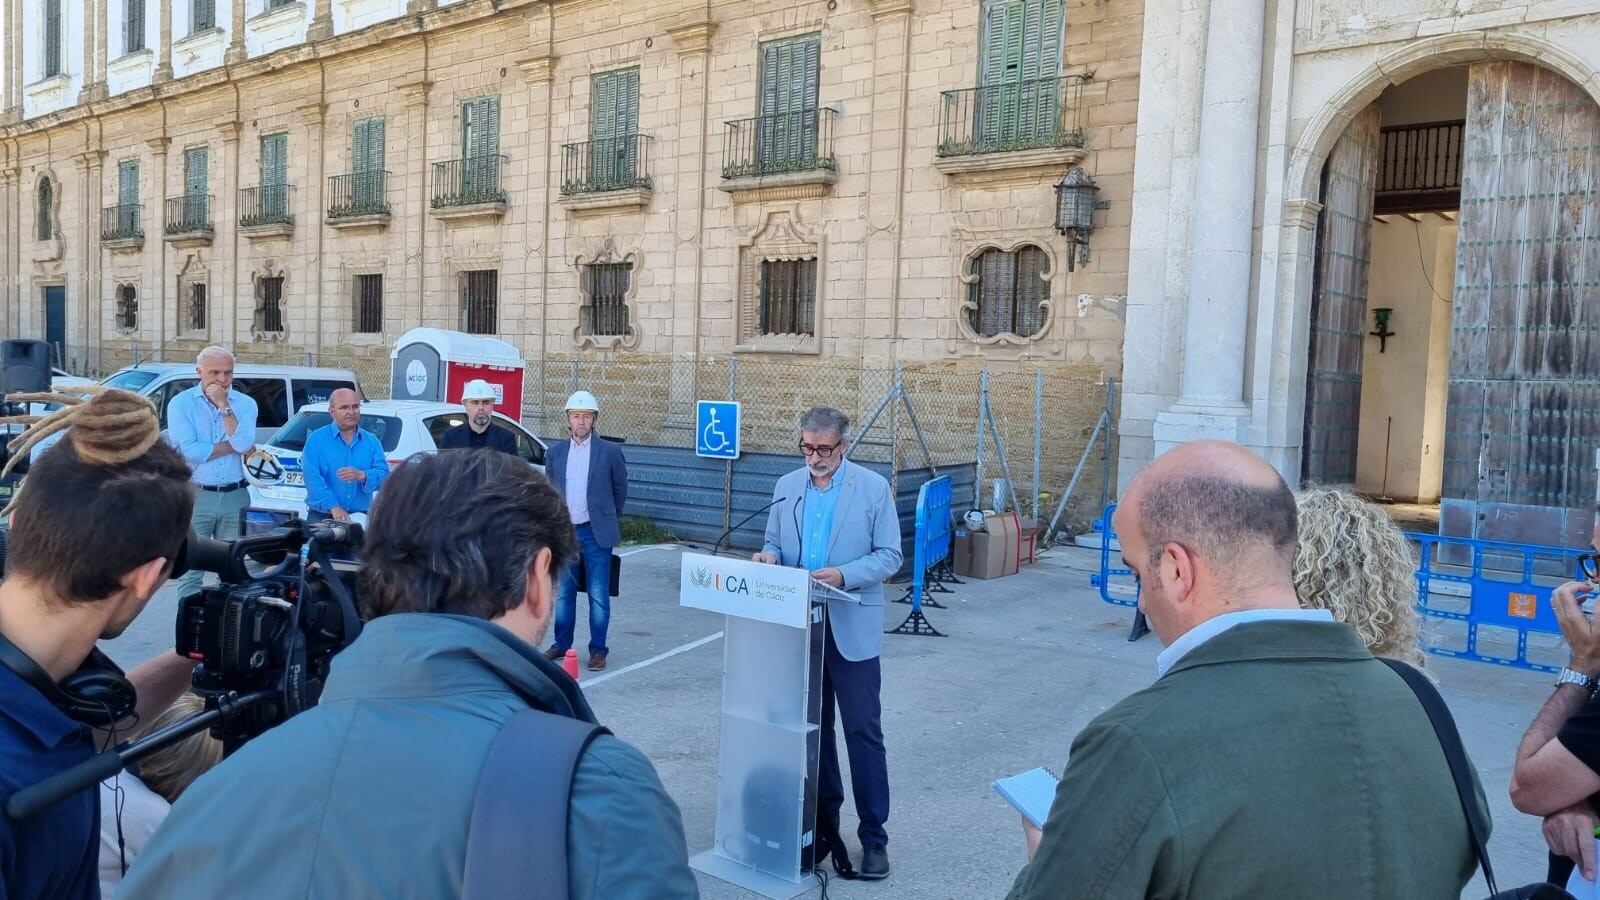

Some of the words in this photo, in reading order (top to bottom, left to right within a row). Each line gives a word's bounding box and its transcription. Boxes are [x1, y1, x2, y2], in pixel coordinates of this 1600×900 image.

[715, 571, 749, 596] UCA
[755, 579, 796, 594] Universidad
[755, 590, 765, 598] de
[766, 591, 785, 602] Cádiz
